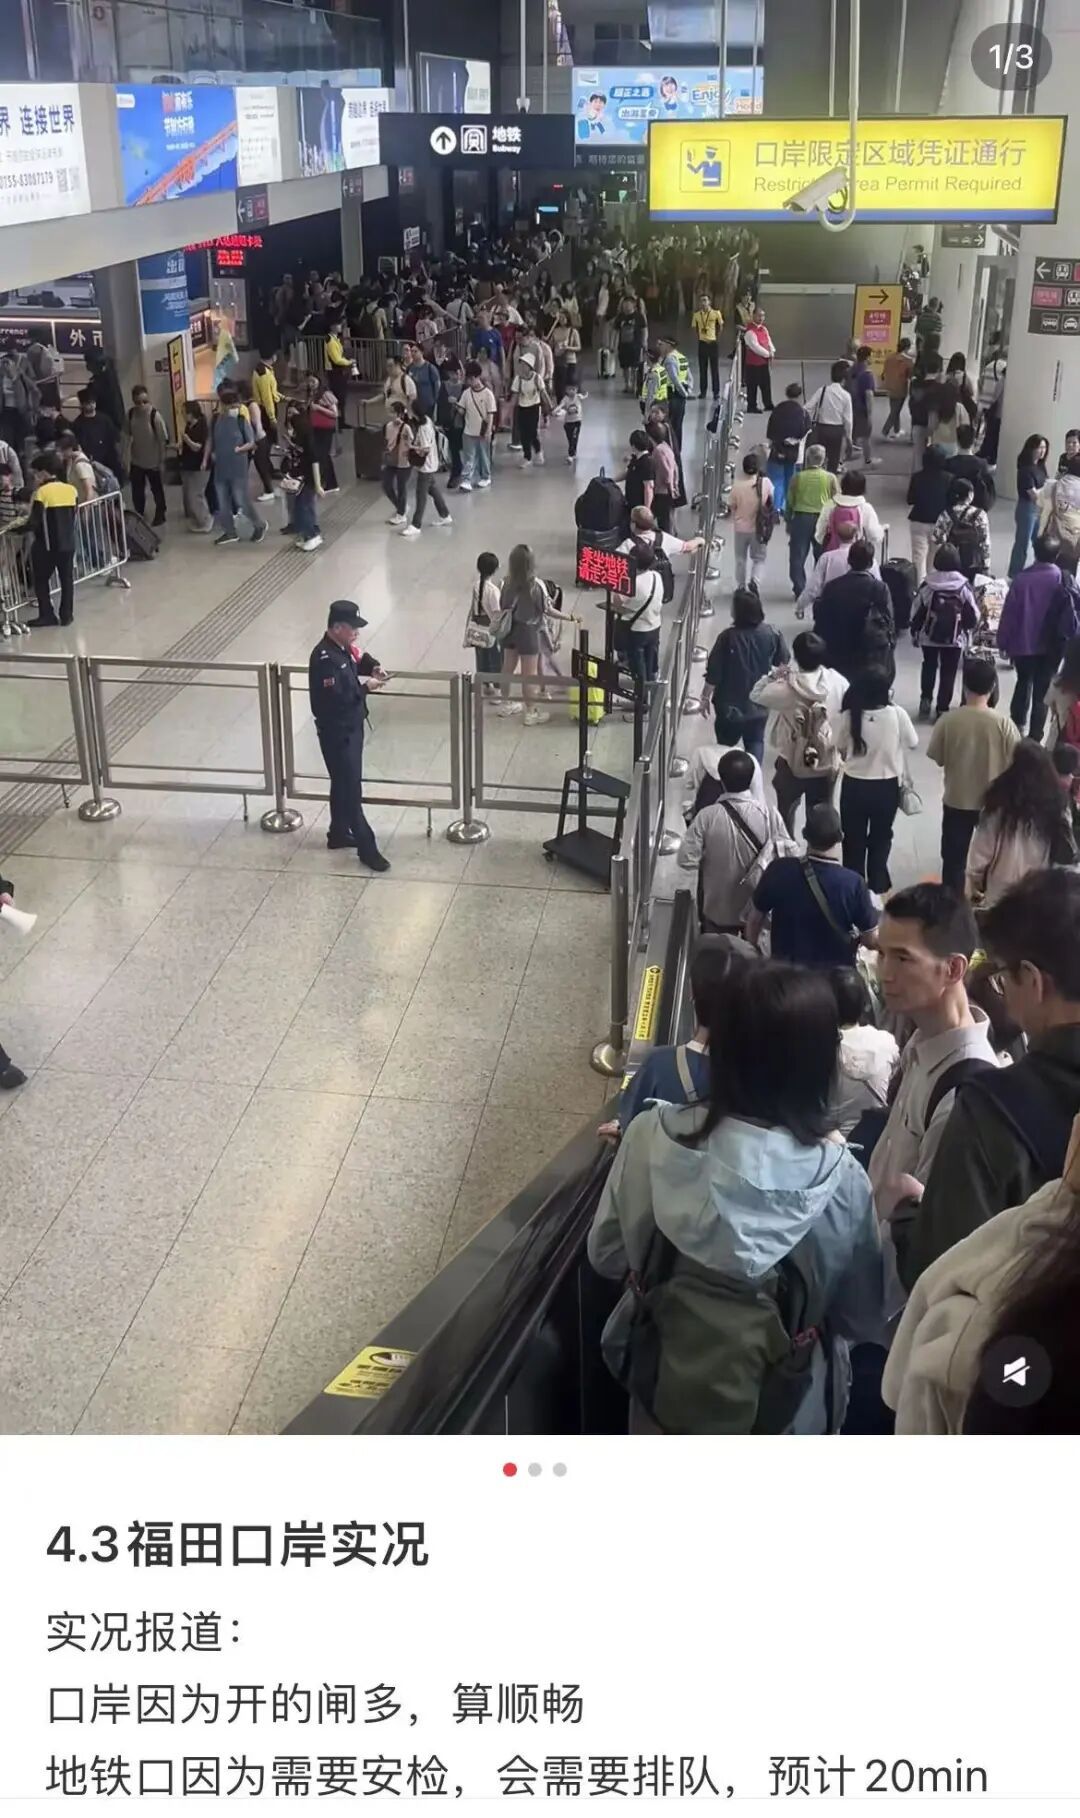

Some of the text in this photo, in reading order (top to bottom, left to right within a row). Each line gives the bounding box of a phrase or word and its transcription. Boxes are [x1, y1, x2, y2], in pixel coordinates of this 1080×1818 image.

[19, 104, 75, 136] 连接世界
[491, 126, 522, 142] 地铁
[755, 138, 1027, 168] 口岸限定区域凭证通行
[886, 175, 939, 192] Permit
[945, 175, 1022, 196] Required
